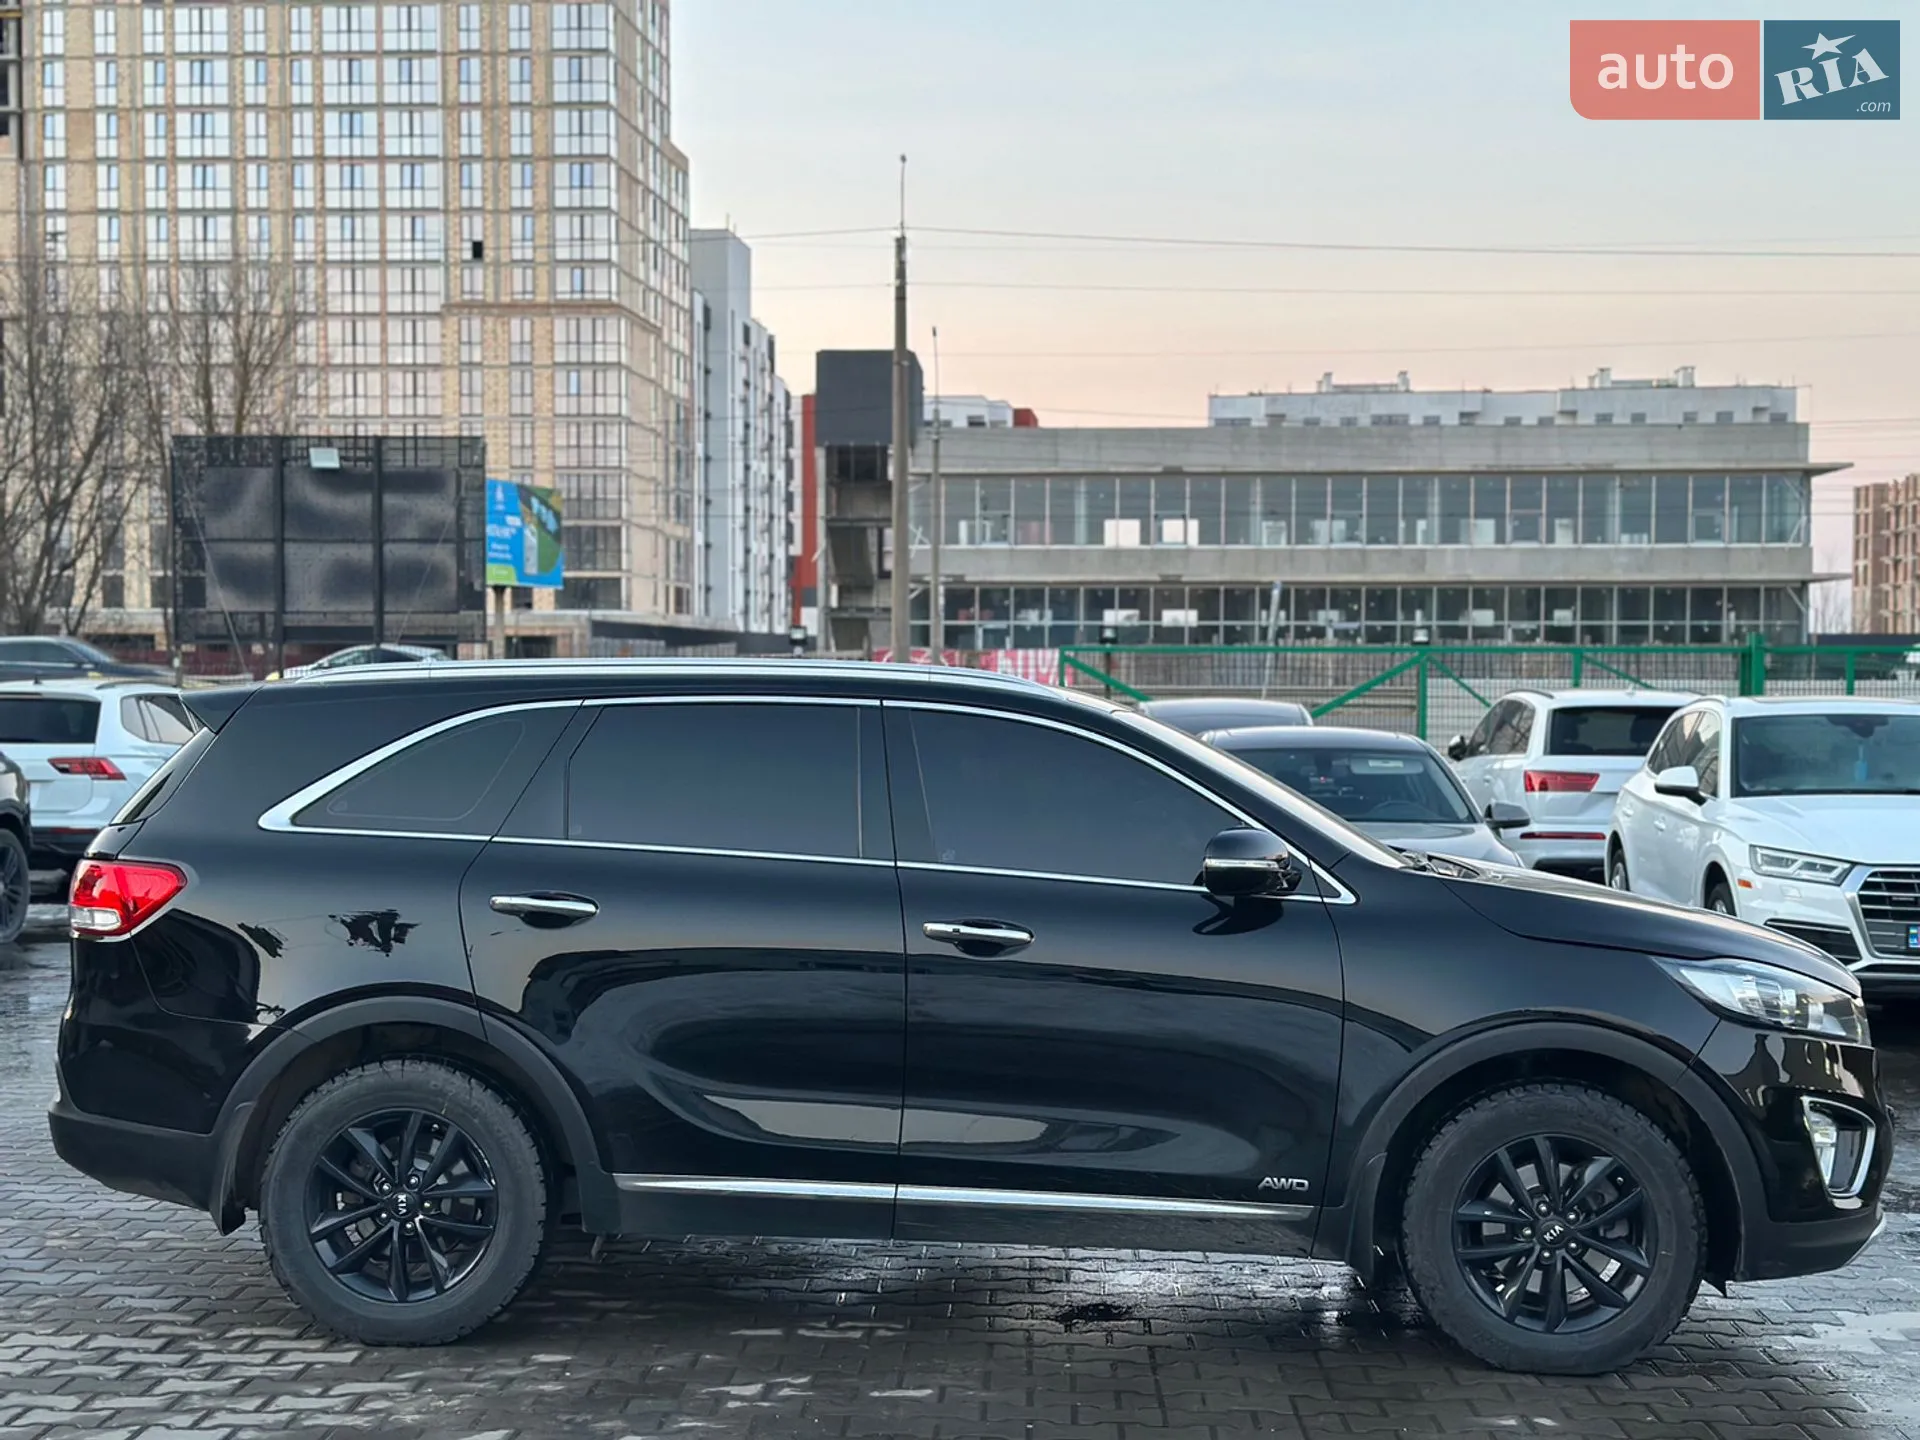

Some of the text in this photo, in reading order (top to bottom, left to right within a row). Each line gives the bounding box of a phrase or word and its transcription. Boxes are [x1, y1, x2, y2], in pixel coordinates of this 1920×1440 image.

[1258, 1177, 1309, 1191] AWD
[398, 1194, 407, 1214] KIA
[1544, 1225, 1563, 1241] KIA
